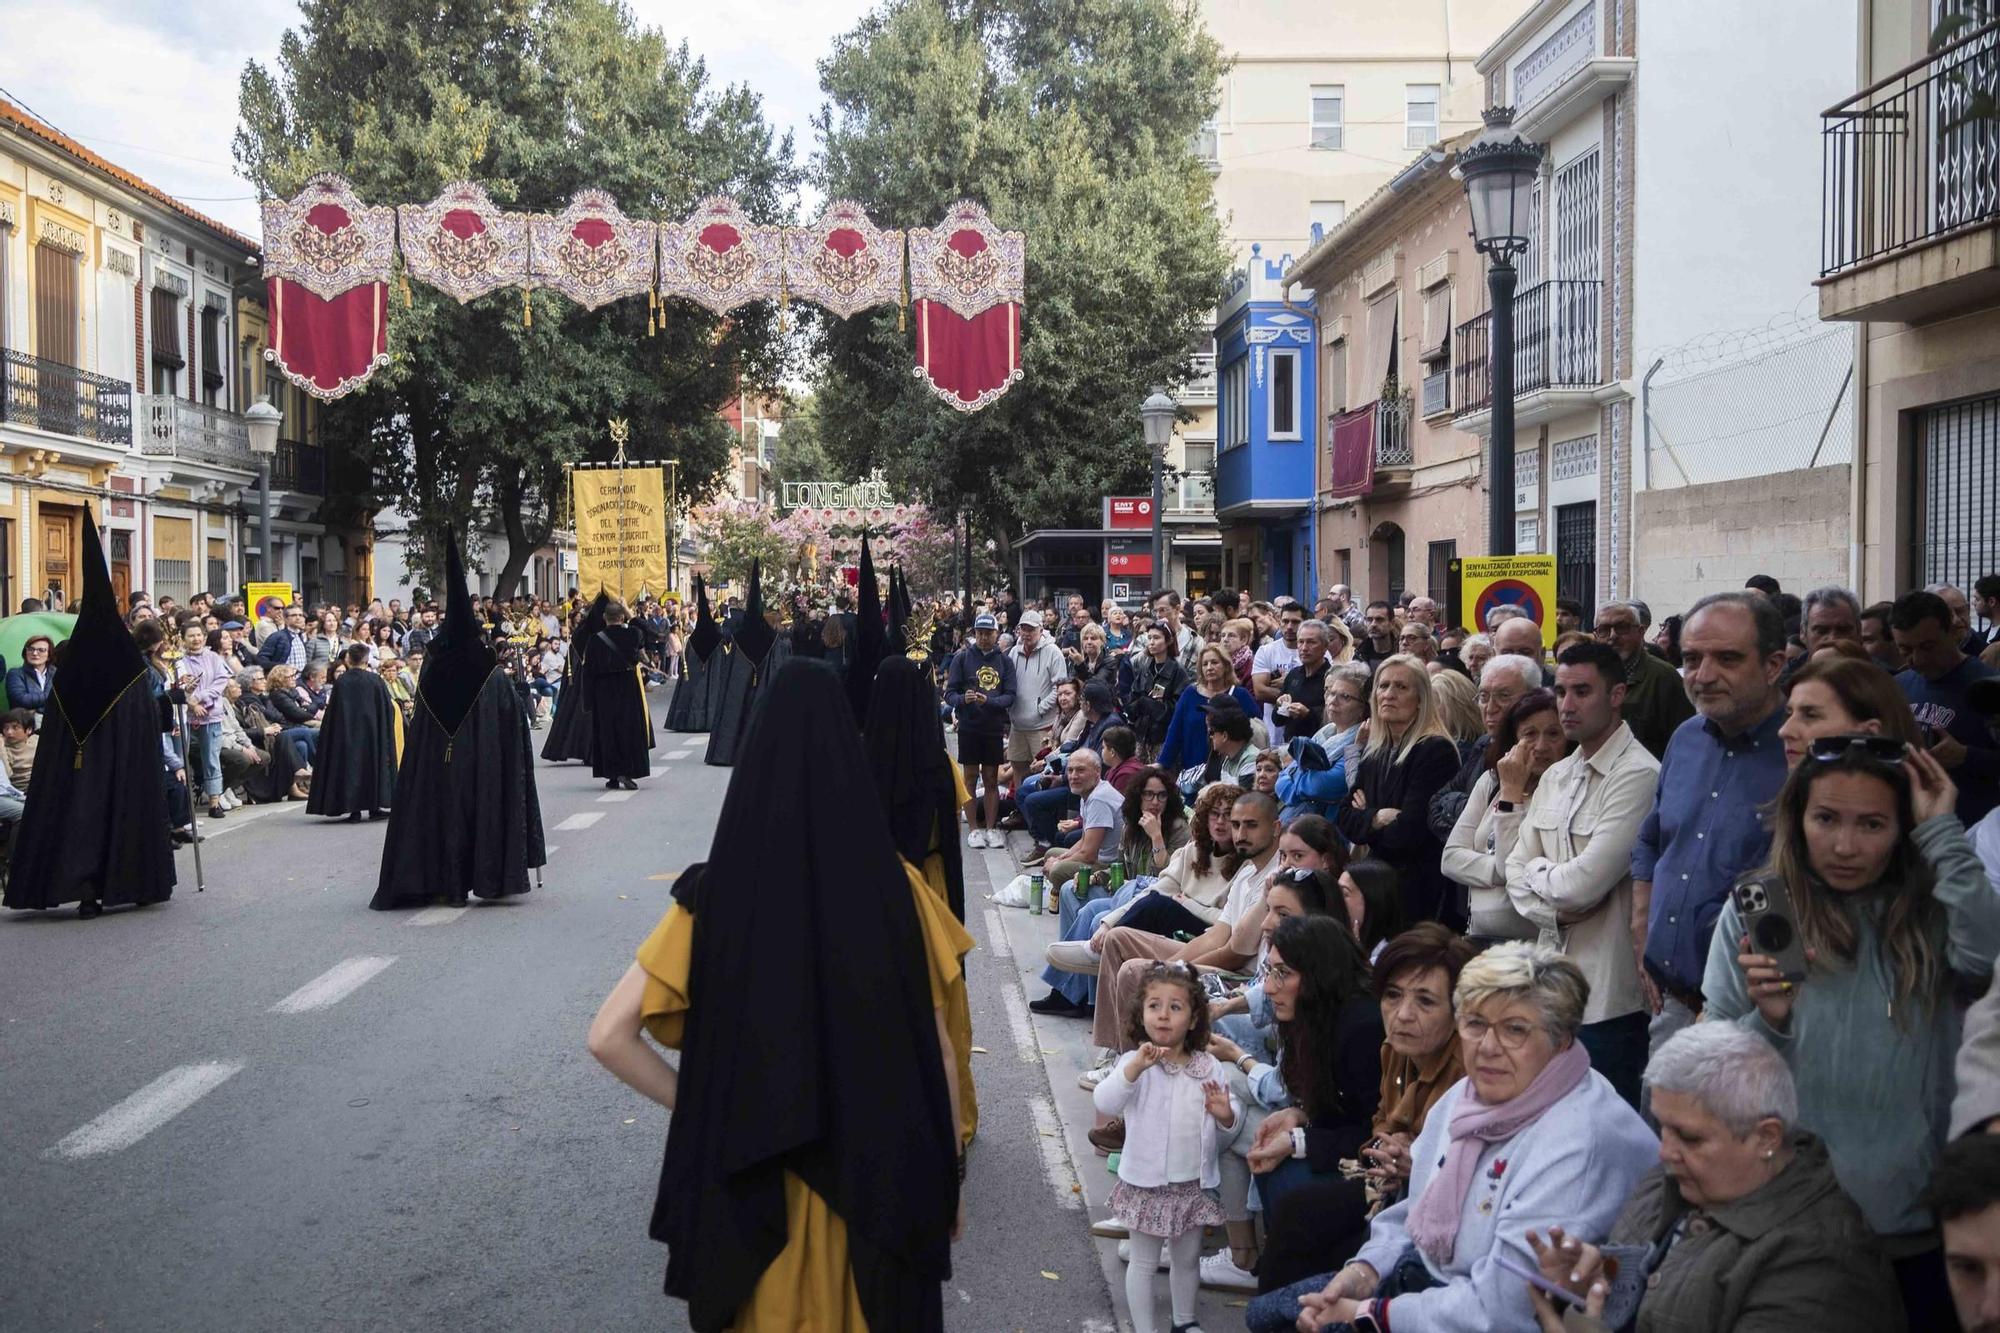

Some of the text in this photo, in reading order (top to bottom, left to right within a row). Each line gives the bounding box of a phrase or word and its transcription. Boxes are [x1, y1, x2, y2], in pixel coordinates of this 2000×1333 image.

[1466, 560, 1553, 571] SENYALITZACIÓ EXCEPCIONAL
[1465, 569, 1550, 578] SEÑALIZACIÓN EXCEPCIONAL
